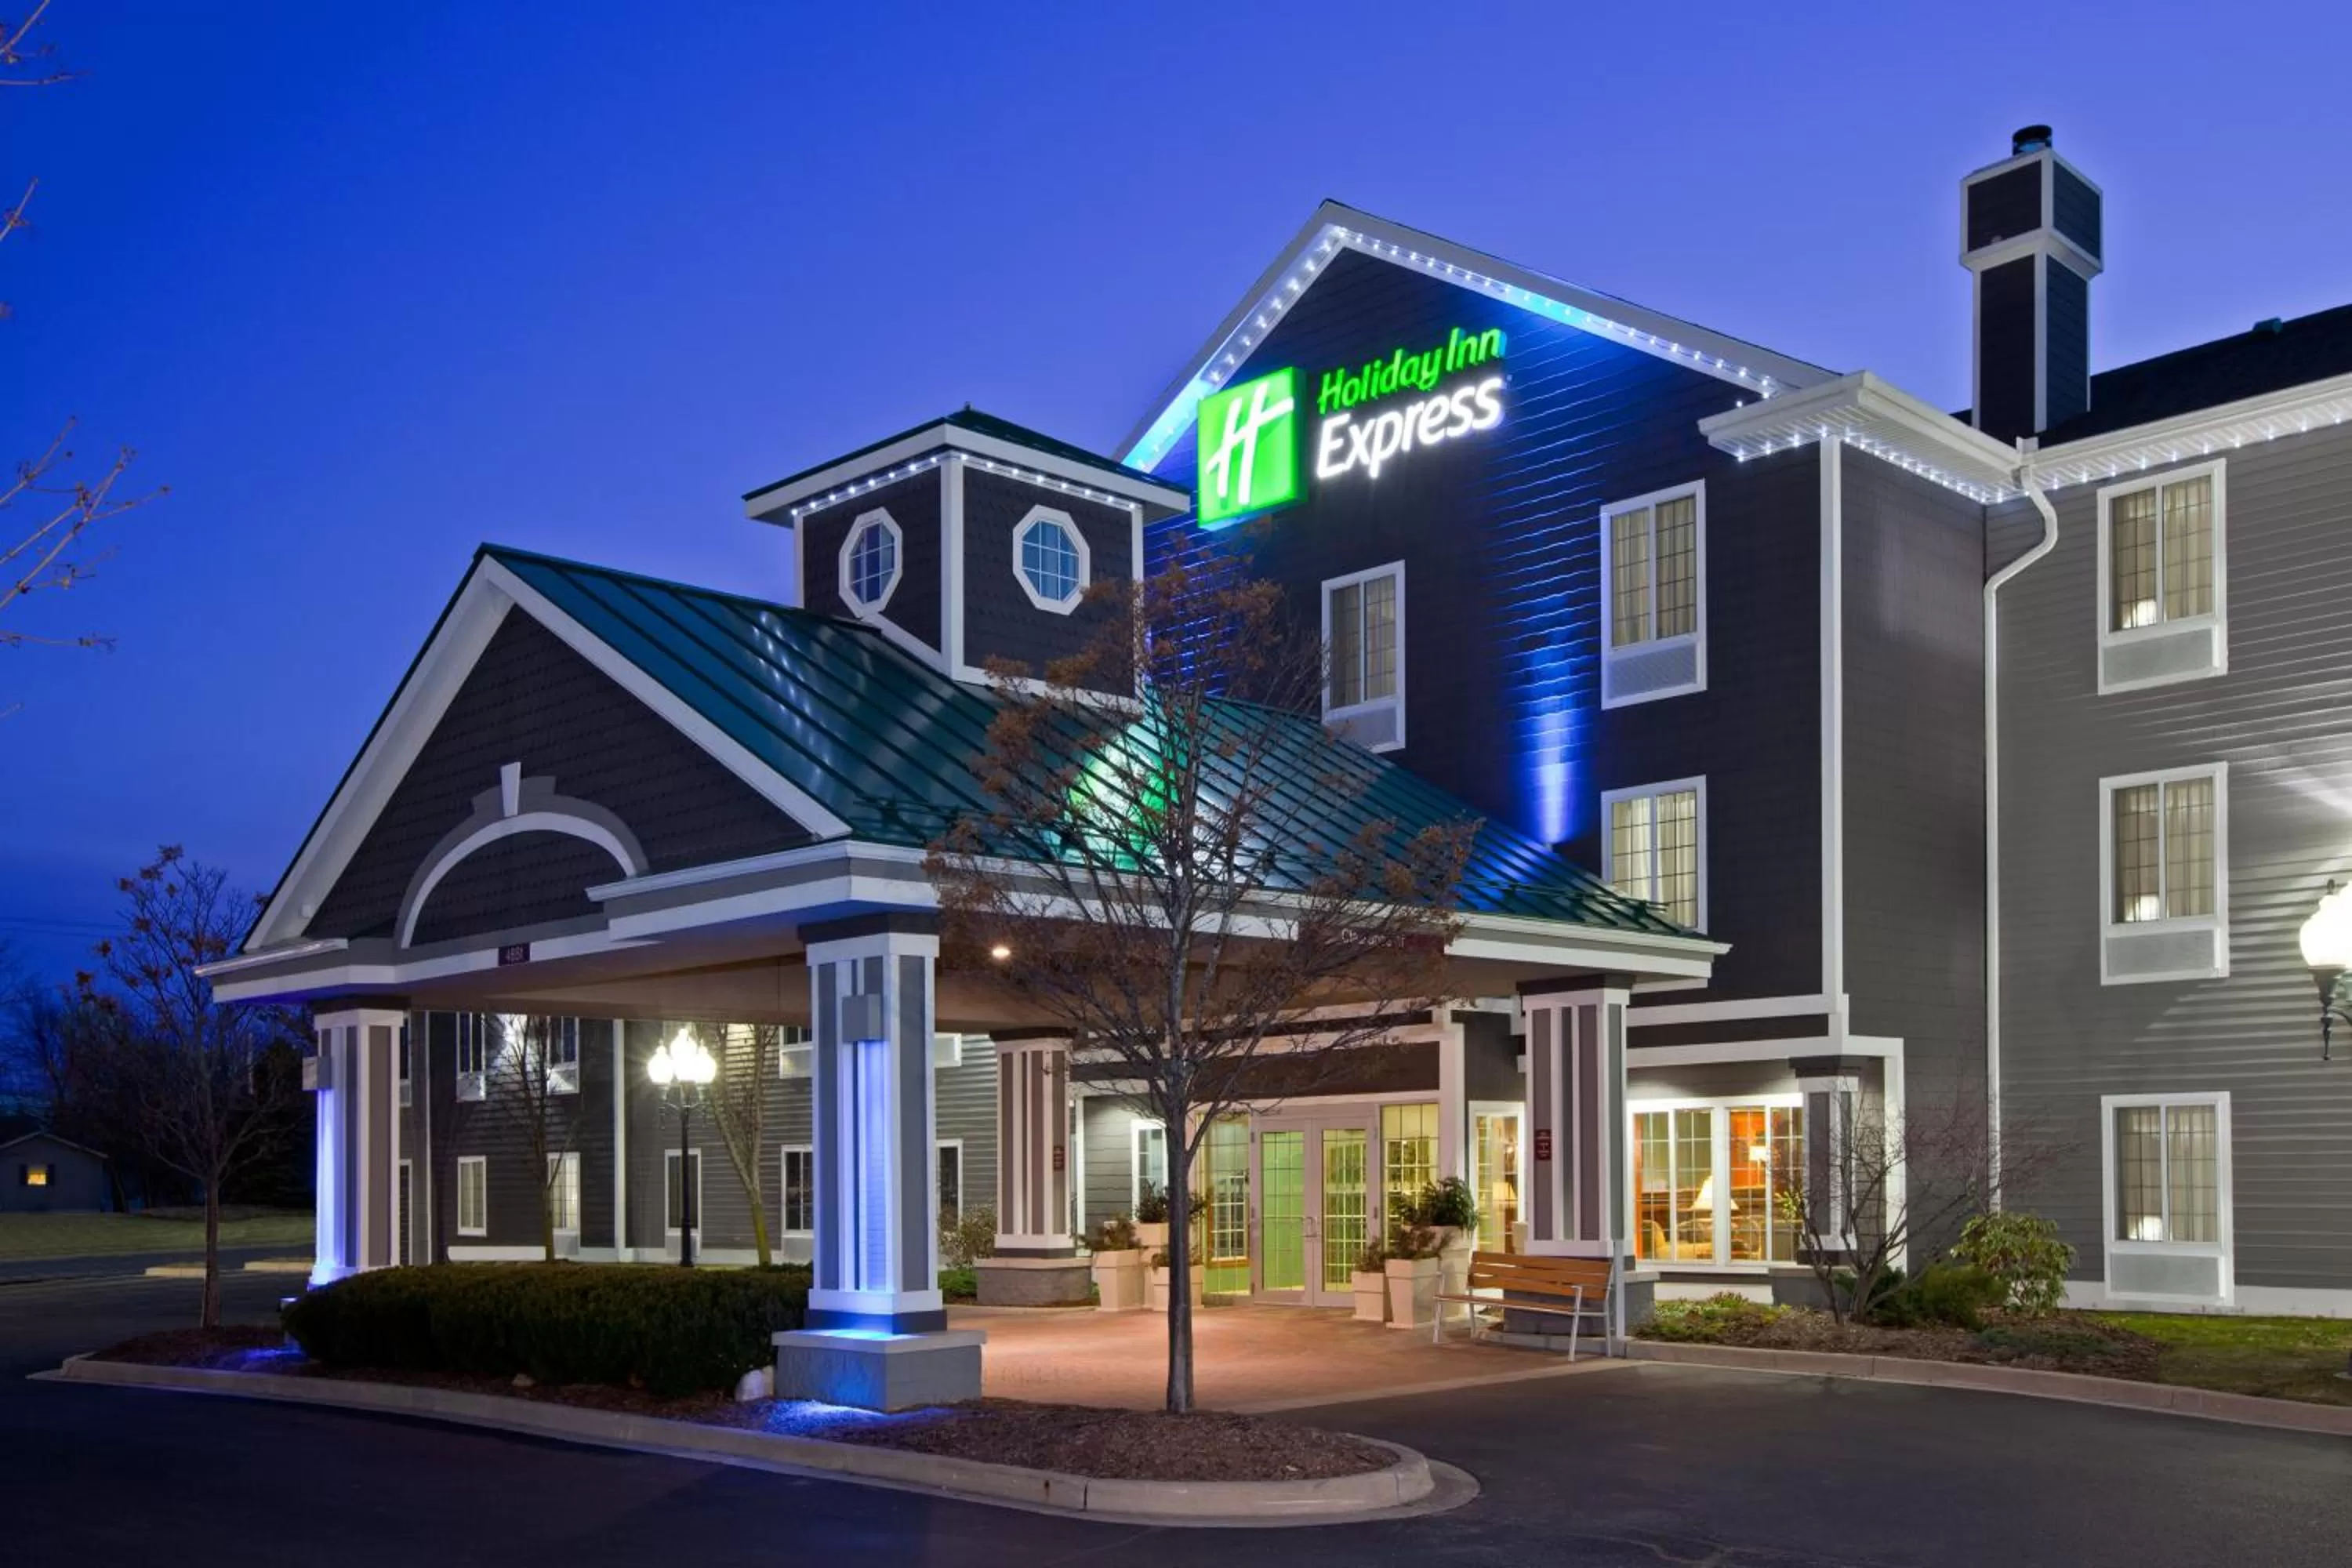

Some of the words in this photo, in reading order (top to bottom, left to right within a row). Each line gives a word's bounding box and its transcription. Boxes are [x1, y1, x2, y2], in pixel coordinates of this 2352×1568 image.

[1317, 347, 1444, 416] Holiday
[1446, 325, 1506, 372] Inn
[1316, 376, 1504, 480] Express
